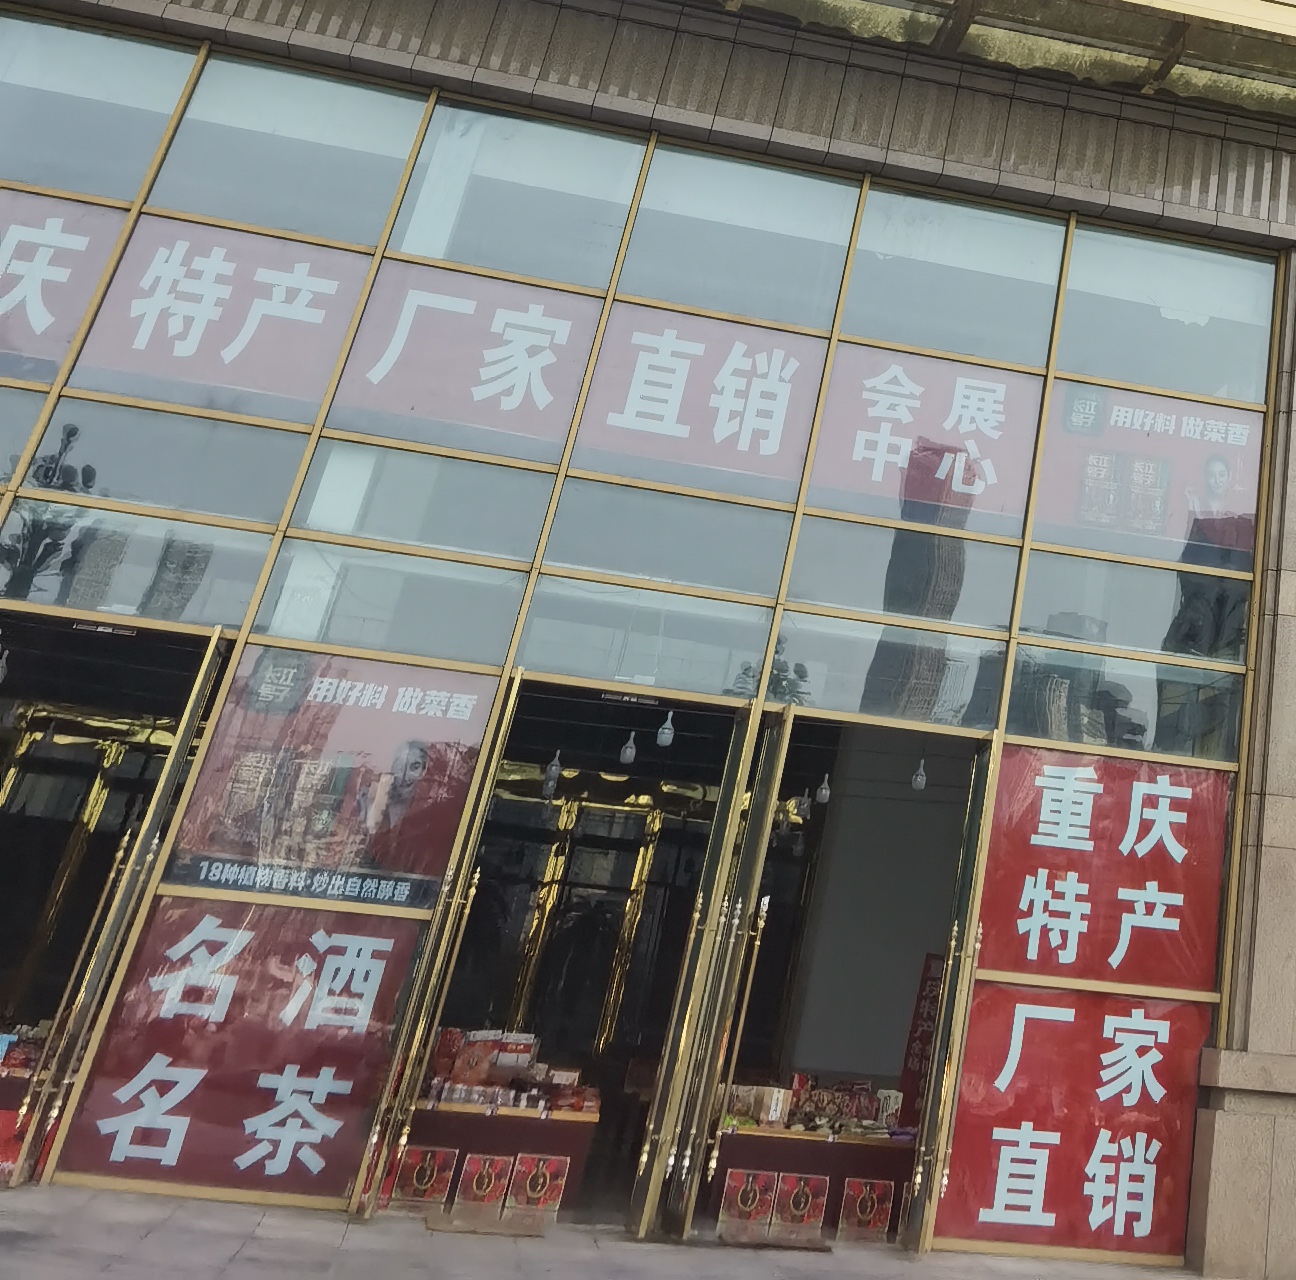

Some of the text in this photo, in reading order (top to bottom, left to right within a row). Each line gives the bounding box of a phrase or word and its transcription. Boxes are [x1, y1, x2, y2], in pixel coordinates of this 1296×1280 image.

[861, 364, 1006, 440] 会展
[1110, 406, 1250, 446] 用好料 做菜香
[852, 423, 997, 496] 中心
[306, 677, 478, 721] 用好料 做菜香
[1030, 764, 1194, 864] 重庆
[1016, 868, 1184, 970] 特产
[148, 913, 395, 1034] 名酒
[993, 1002, 1171, 1107] 厂家
[96, 1053, 353, 1177] 名茶
[978, 1121, 1163, 1238] 直销
